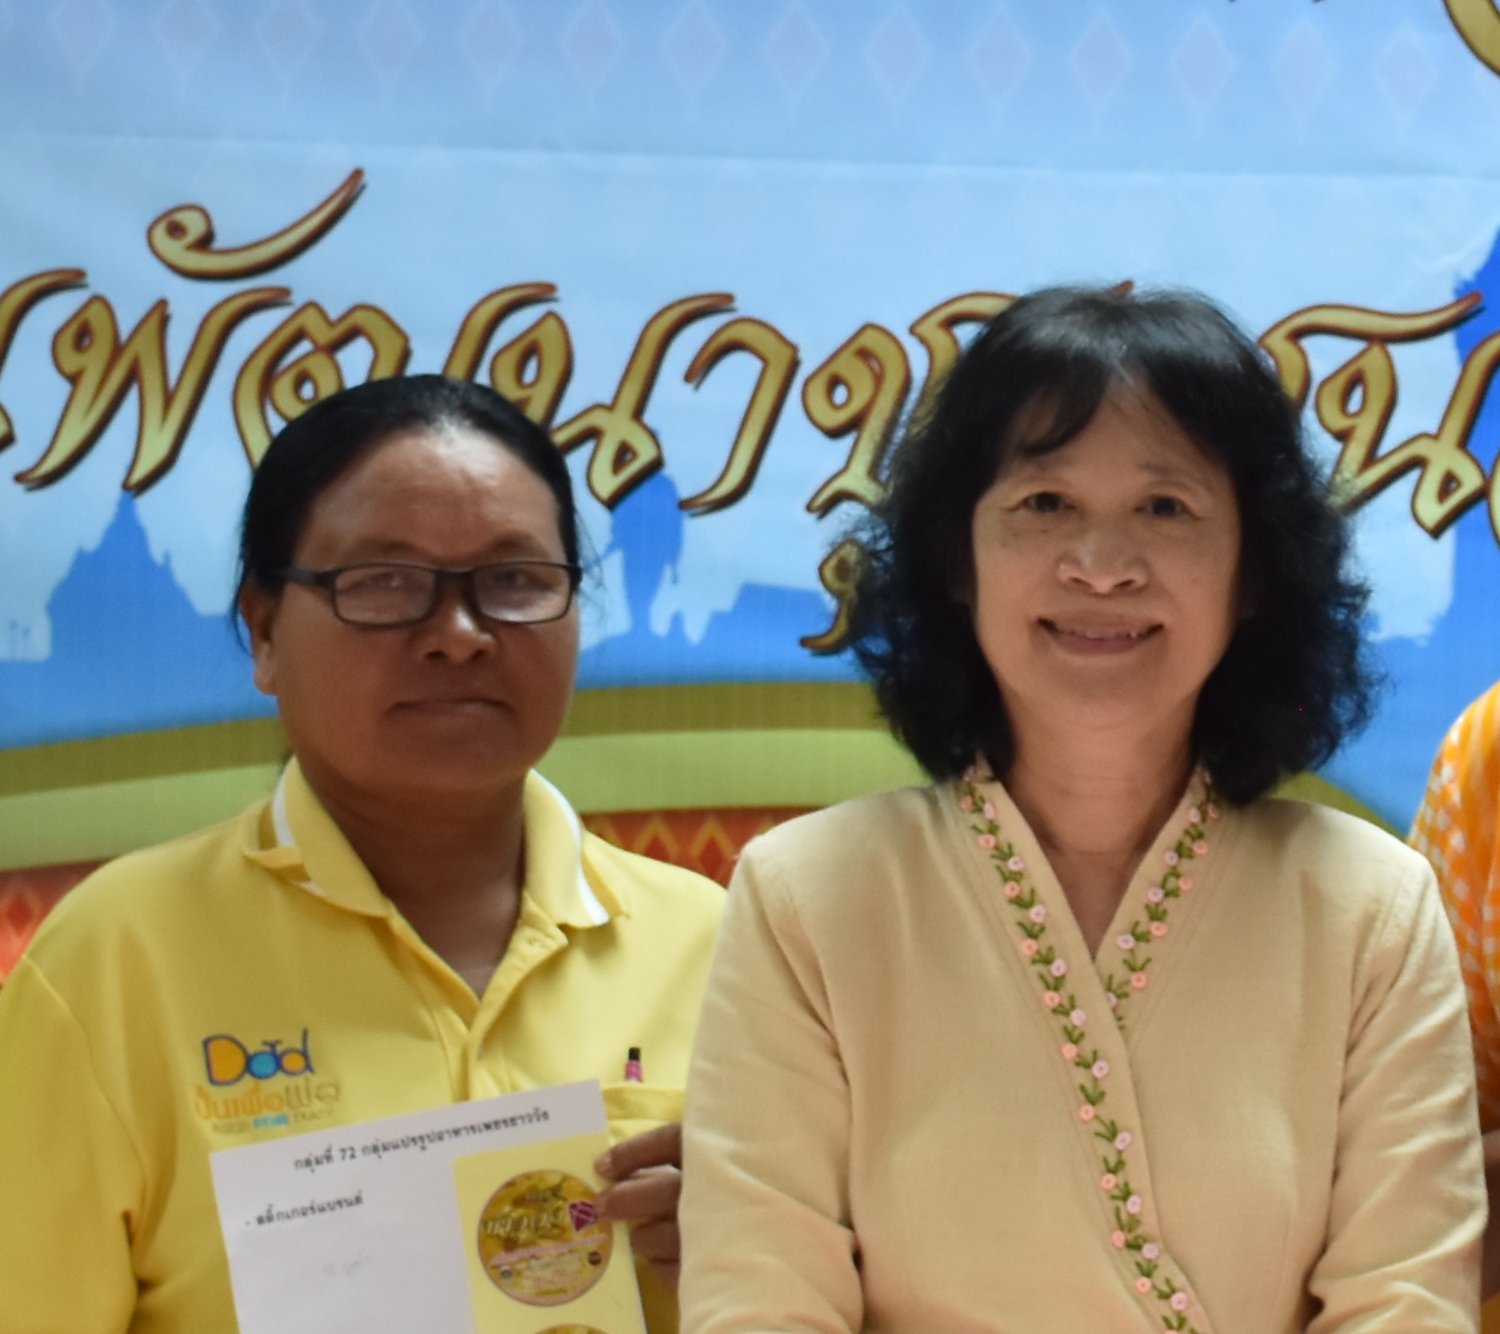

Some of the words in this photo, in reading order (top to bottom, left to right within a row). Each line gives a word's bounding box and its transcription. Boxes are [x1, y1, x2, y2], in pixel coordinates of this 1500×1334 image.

[294, 1143, 334, 1173] กลุ่มที่
[339, 1146, 357, 1161] 72
